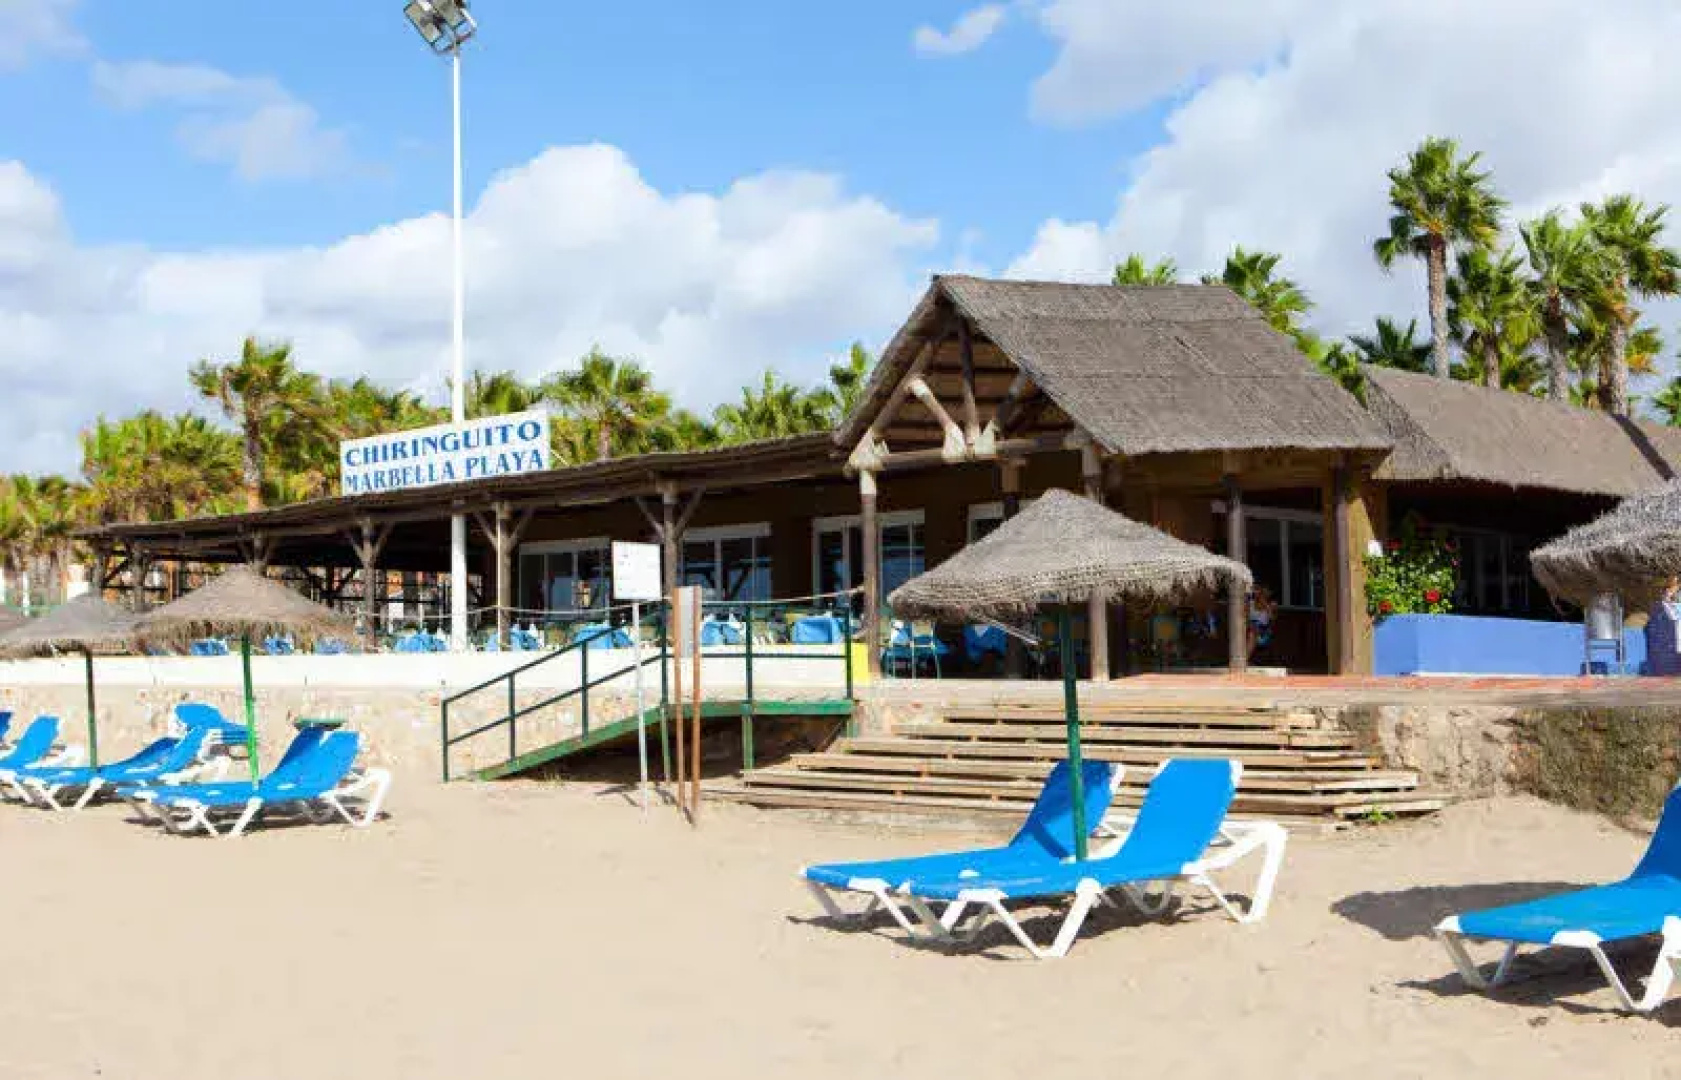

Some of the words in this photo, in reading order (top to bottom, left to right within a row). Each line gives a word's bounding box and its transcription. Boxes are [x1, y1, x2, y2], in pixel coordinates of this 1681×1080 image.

[345, 420, 541, 467] CHIRINGUITO
[344, 461, 455, 491] MARBELLA
[466, 449, 543, 477] PLAYA
